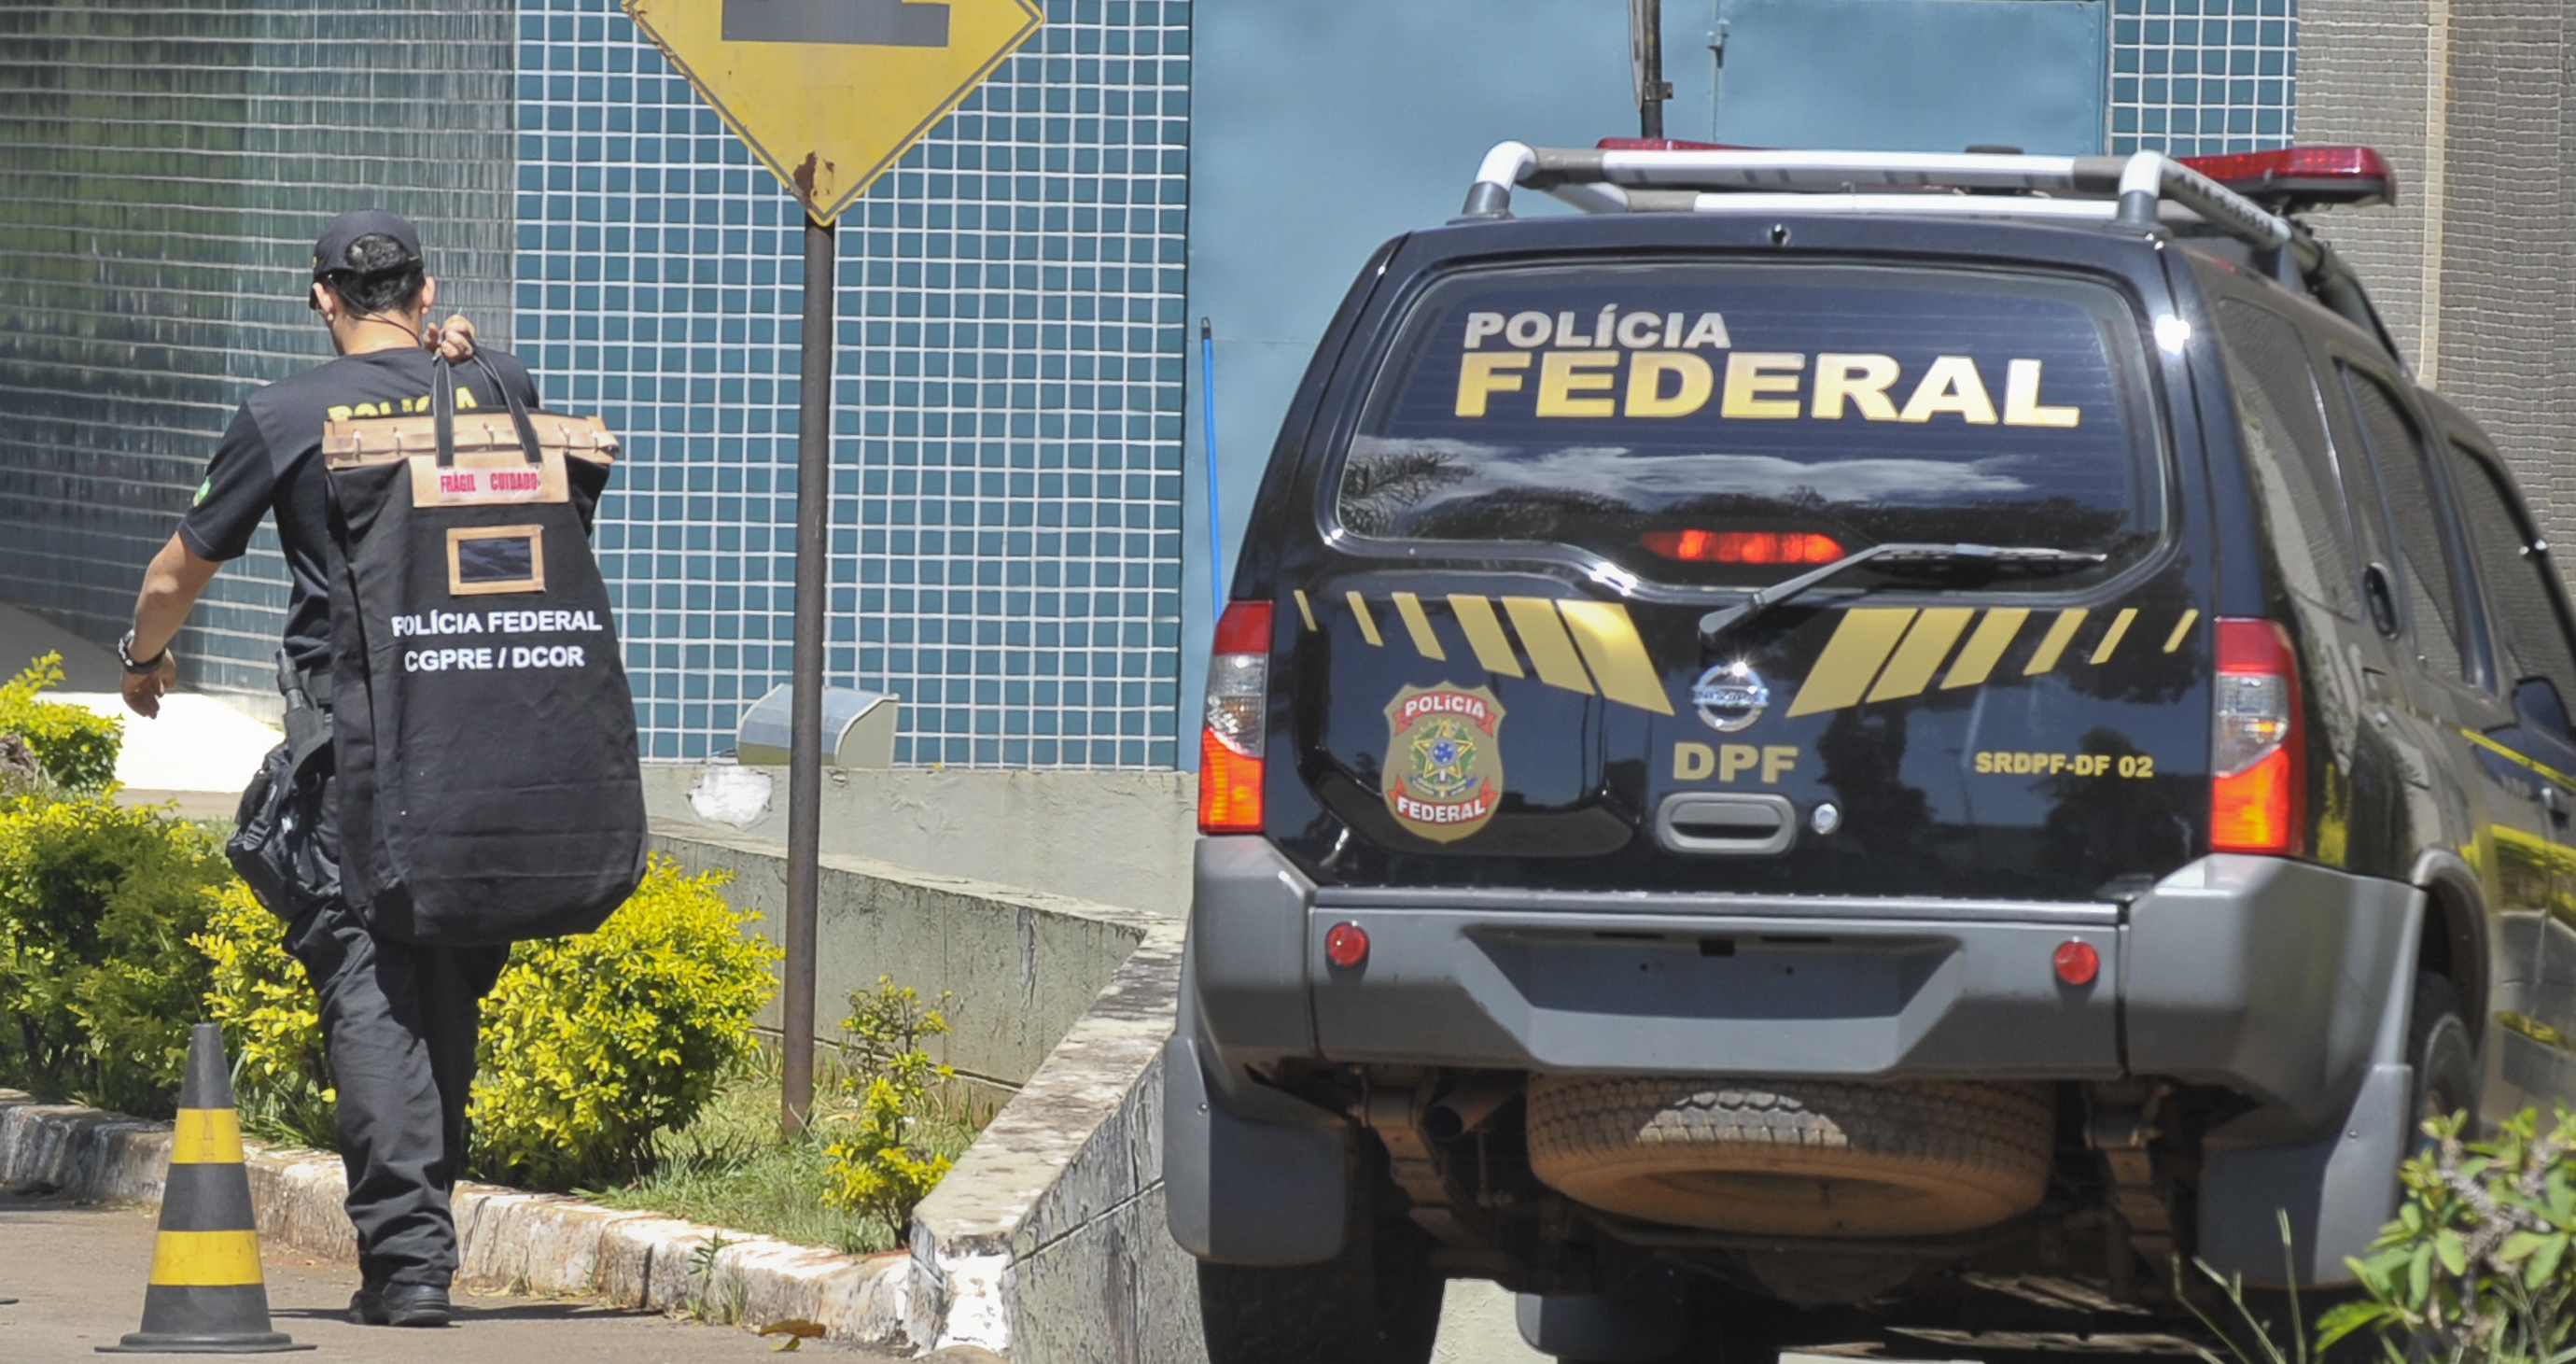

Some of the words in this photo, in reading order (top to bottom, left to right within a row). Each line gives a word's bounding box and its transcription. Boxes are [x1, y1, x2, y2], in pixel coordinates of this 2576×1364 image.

[1463, 303, 1731, 349] POLÍCIA
[1455, 351, 2080, 427] FEDERAL
[390, 610, 483, 637] POLÍCIA
[487, 610, 603, 633] FEDERAL
[404, 647, 493, 672] CGPRE
[512, 645, 585, 668] DCOR
[1673, 742, 1799, 783] DPF
[1975, 752, 2111, 776] SRDPF-DF
[2118, 755, 2154, 778] 02
[1397, 795, 1487, 823] FEDERAL
